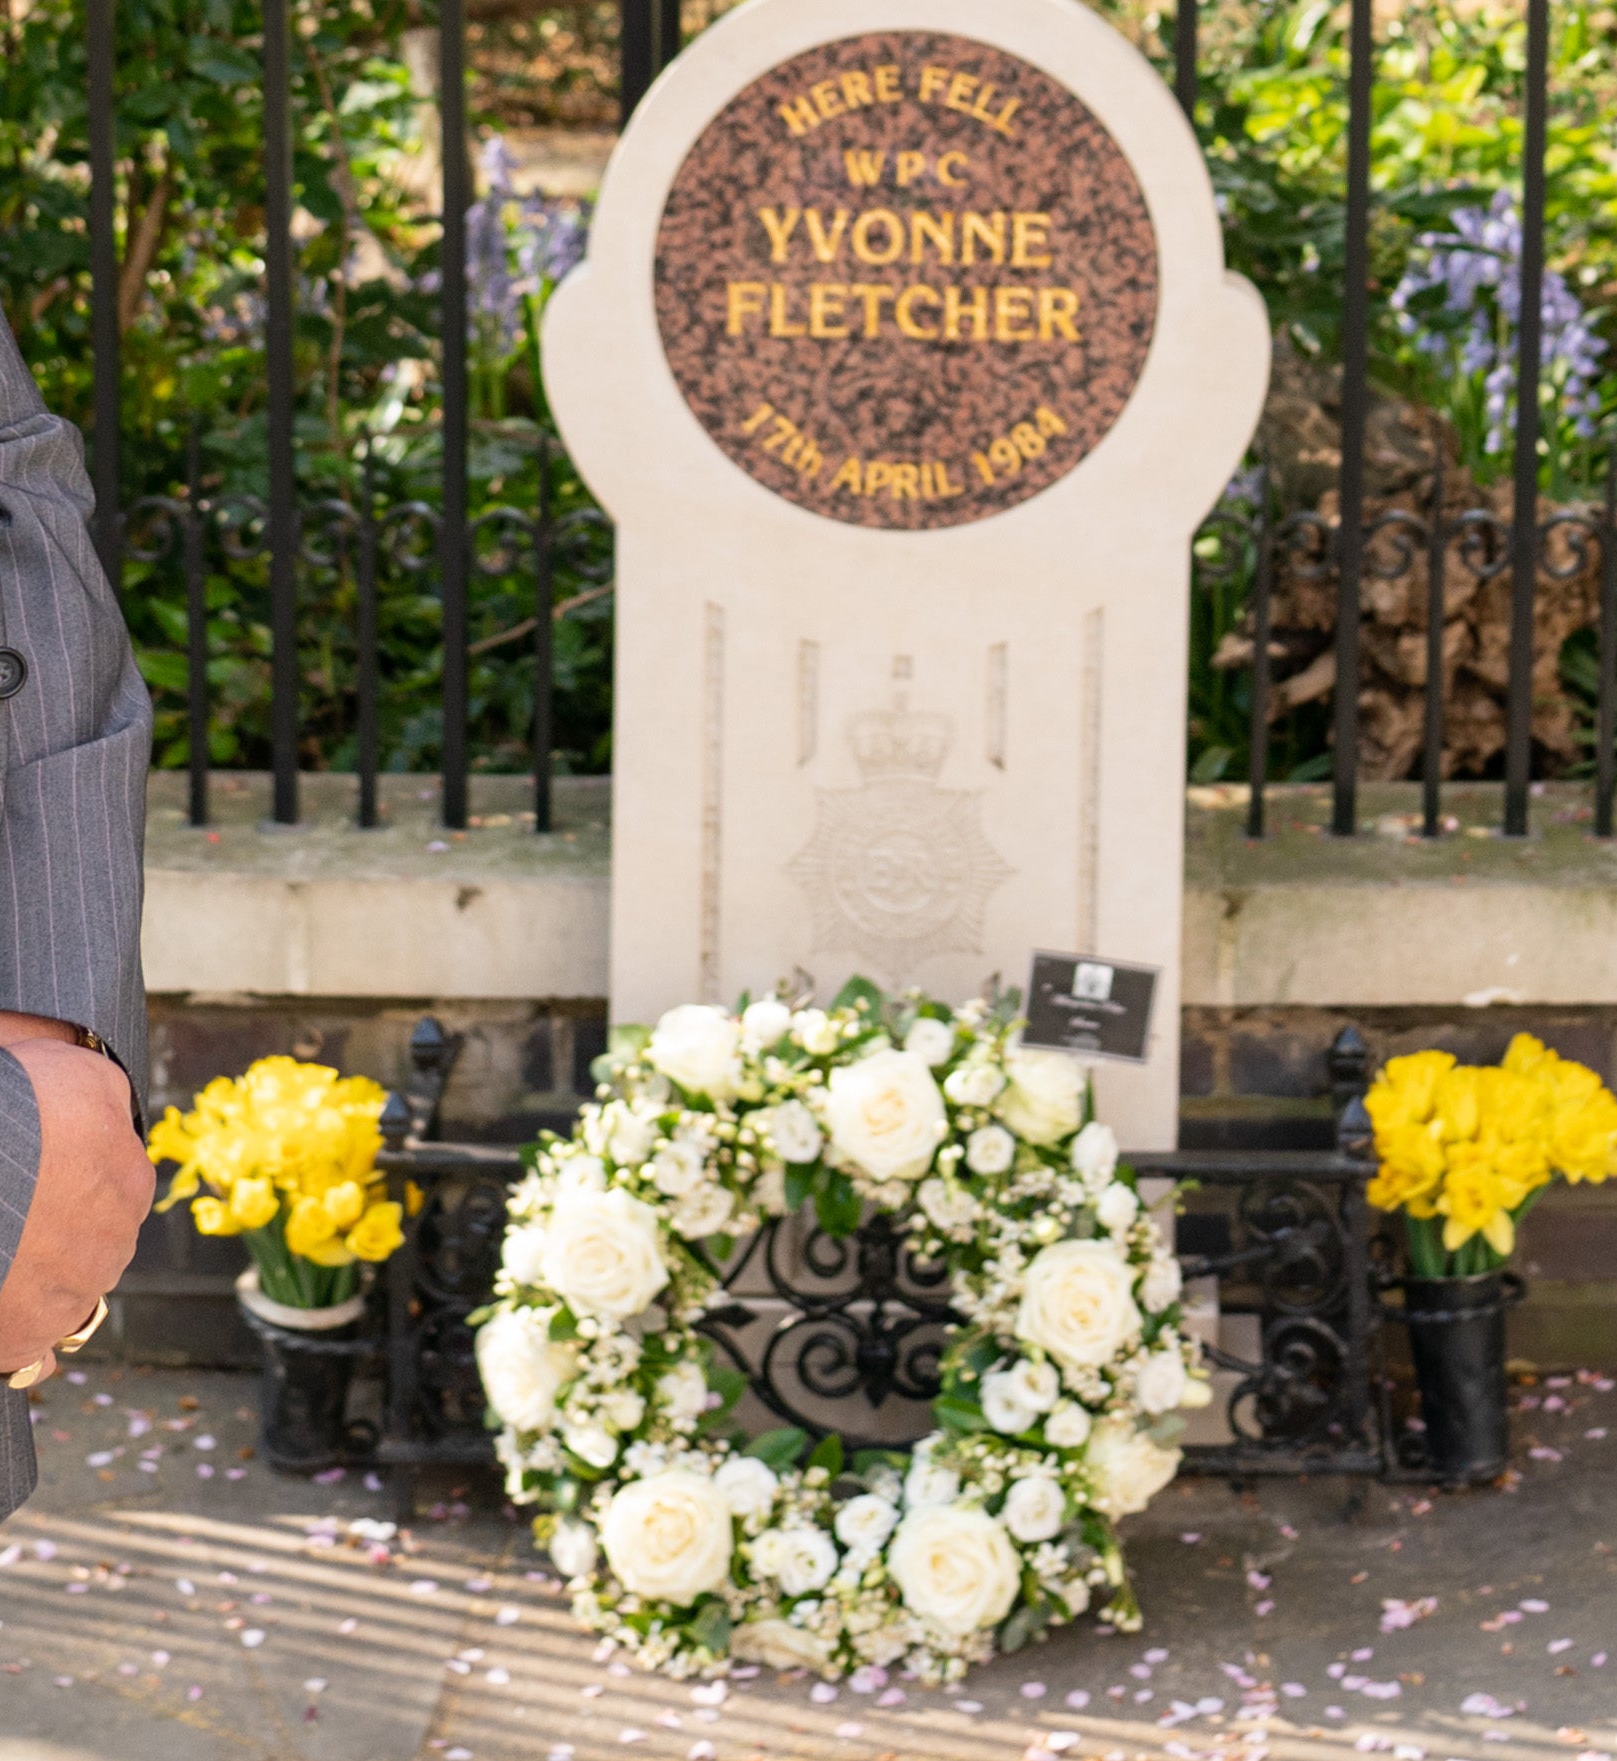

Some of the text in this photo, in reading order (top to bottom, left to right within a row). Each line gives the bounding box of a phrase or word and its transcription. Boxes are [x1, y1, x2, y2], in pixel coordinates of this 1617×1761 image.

[779, 64, 1021, 137] HERE FELL
[757, 208, 1052, 268] YVONNE
[725, 282, 1082, 341] FLETCHER
[831, 456, 965, 500] APRIL
[971, 406, 1067, 487] 1984
